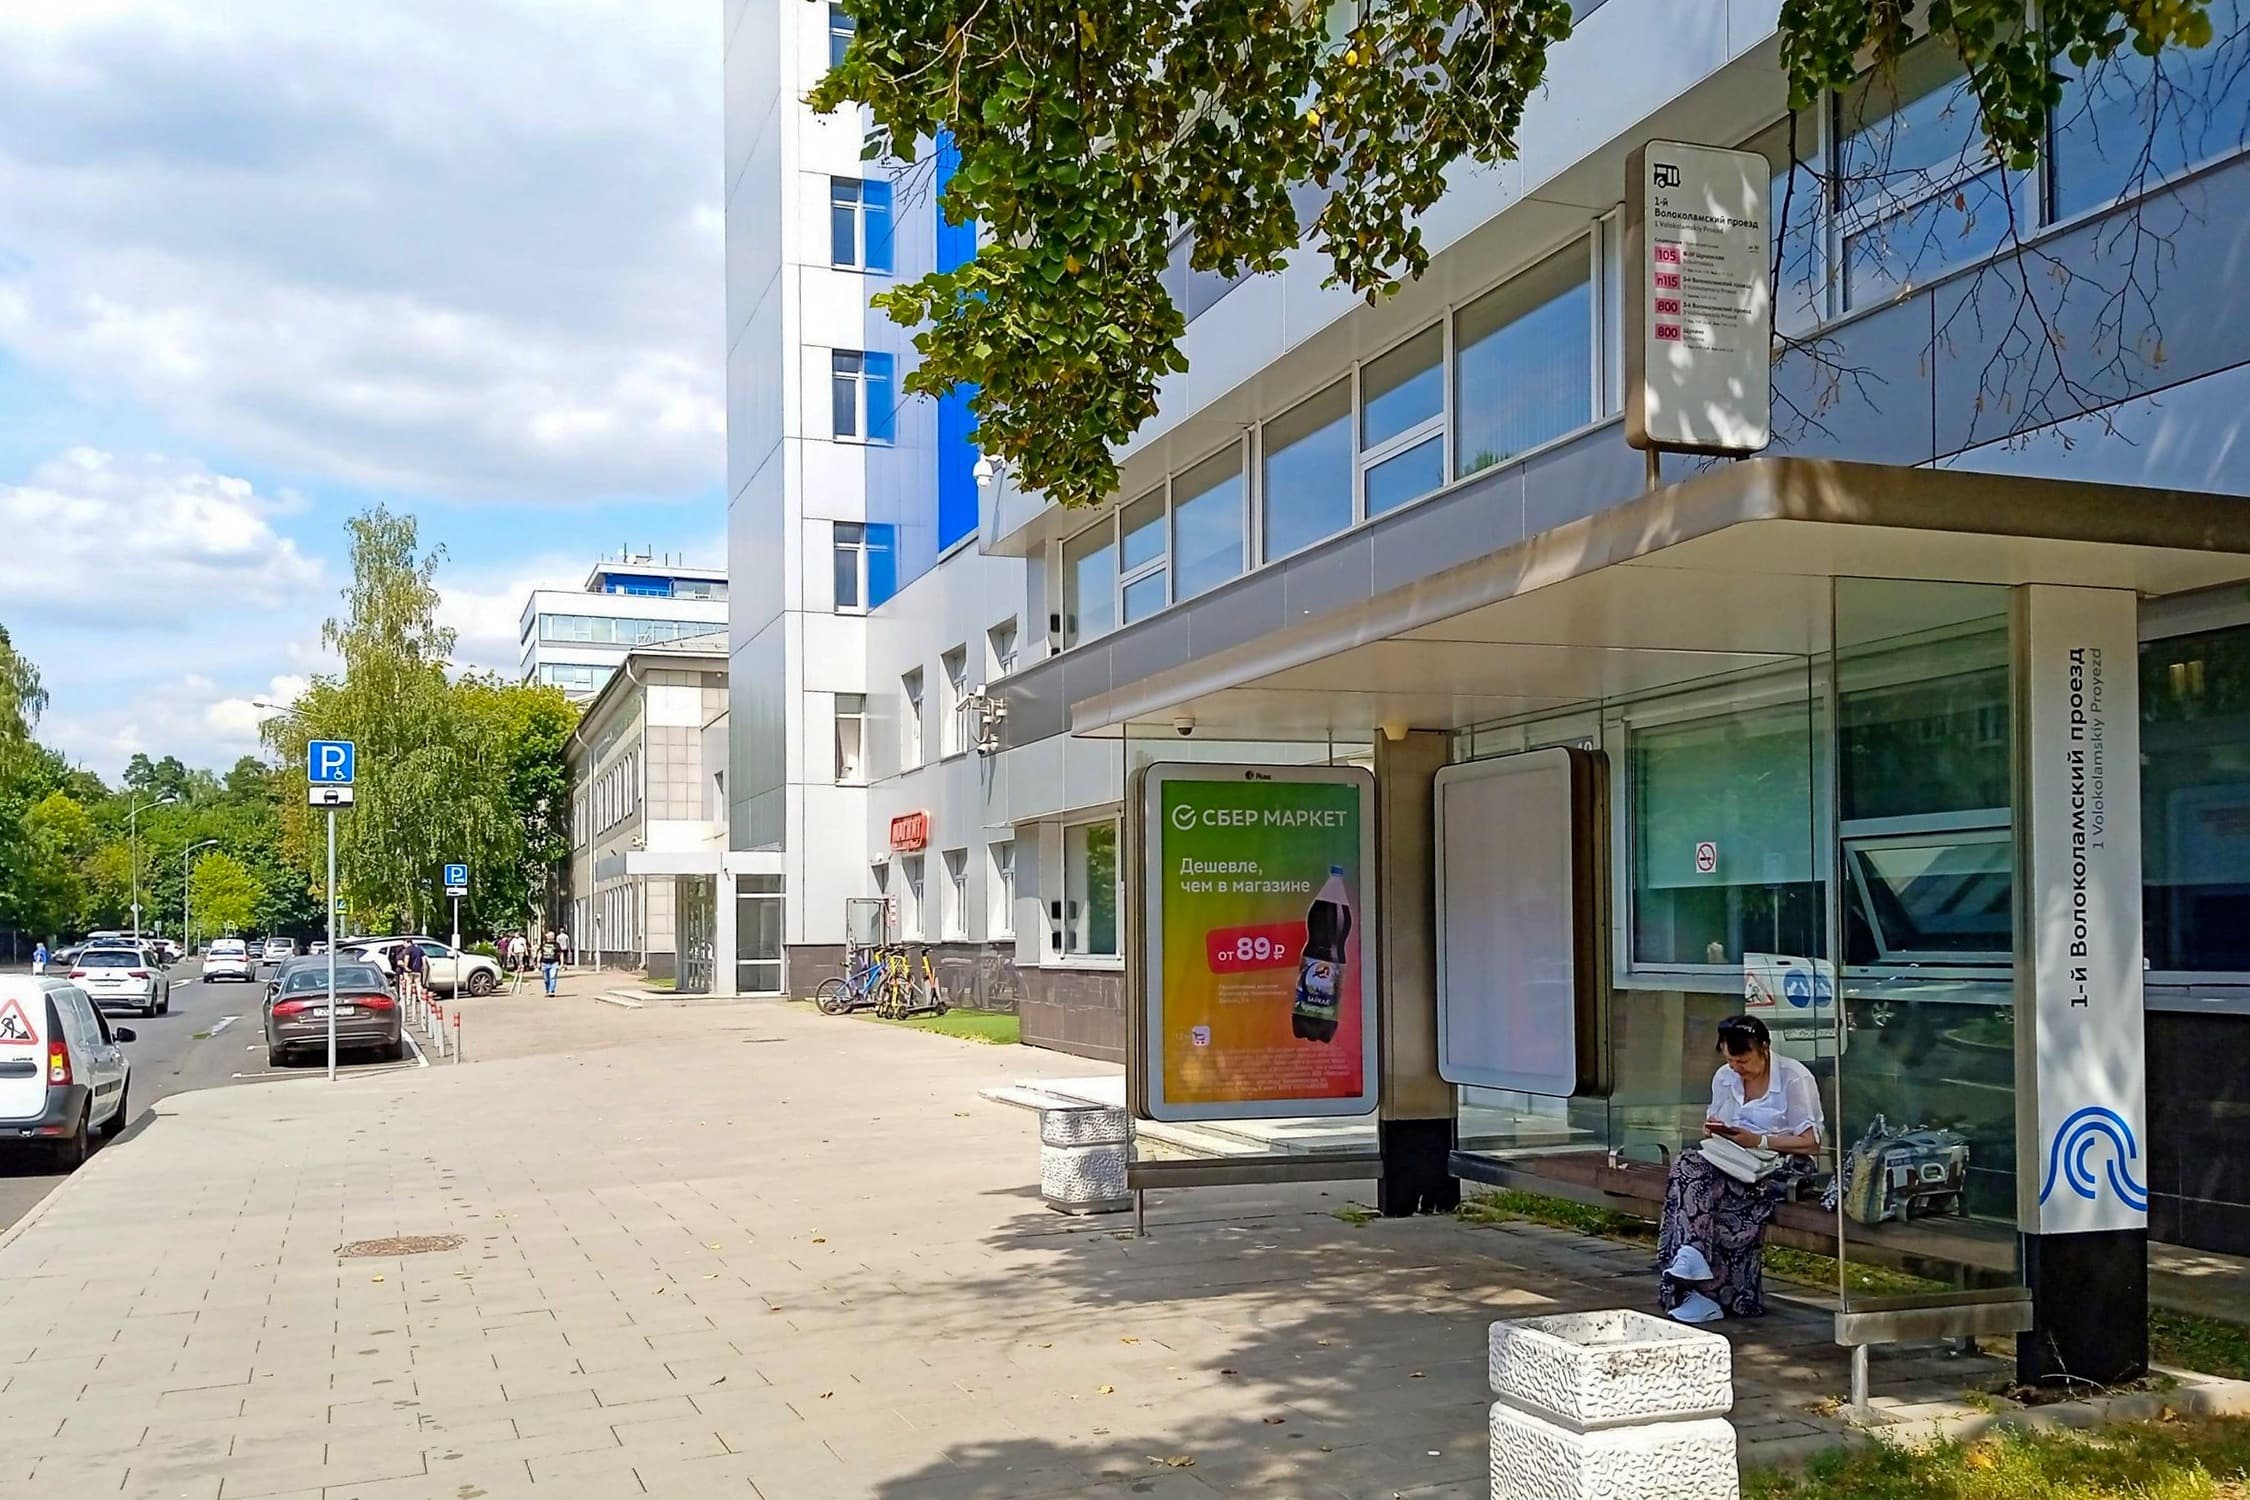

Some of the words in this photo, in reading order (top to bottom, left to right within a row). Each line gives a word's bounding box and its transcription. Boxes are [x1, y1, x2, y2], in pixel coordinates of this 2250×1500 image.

[1654, 196, 1669, 206] 1-й
[1654, 207, 1726, 224] Волоколамский
[1727, 217, 1759, 229] проезд
[1658, 250, 1677, 261] 105
[1657, 301, 1678, 312] 800
[1657, 326, 1678, 338] 800
[2088, 647, 2105, 713] Proyezd
[2069, 648, 2087, 741] проезд
[321, 745, 346, 778] P
[2090, 719, 2105, 836] Volokolamskiy
[1202, 809, 1259, 826] СБЕР
[1263, 810, 1348, 827] МАРКЕТ
[2067, 750, 2088, 957] Волоколамский
[2092, 841, 2104, 849] 1
[1179, 857, 1264, 877] Дешевле,
[1180, 881, 1213, 893] чем
[1217, 881, 1228, 893] в
[1232, 880, 1312, 893] магазине
[1217, 950, 1235, 961] от
[1236, 936, 1271, 961] 89
[2070, 967, 2088, 1008] 1-й
